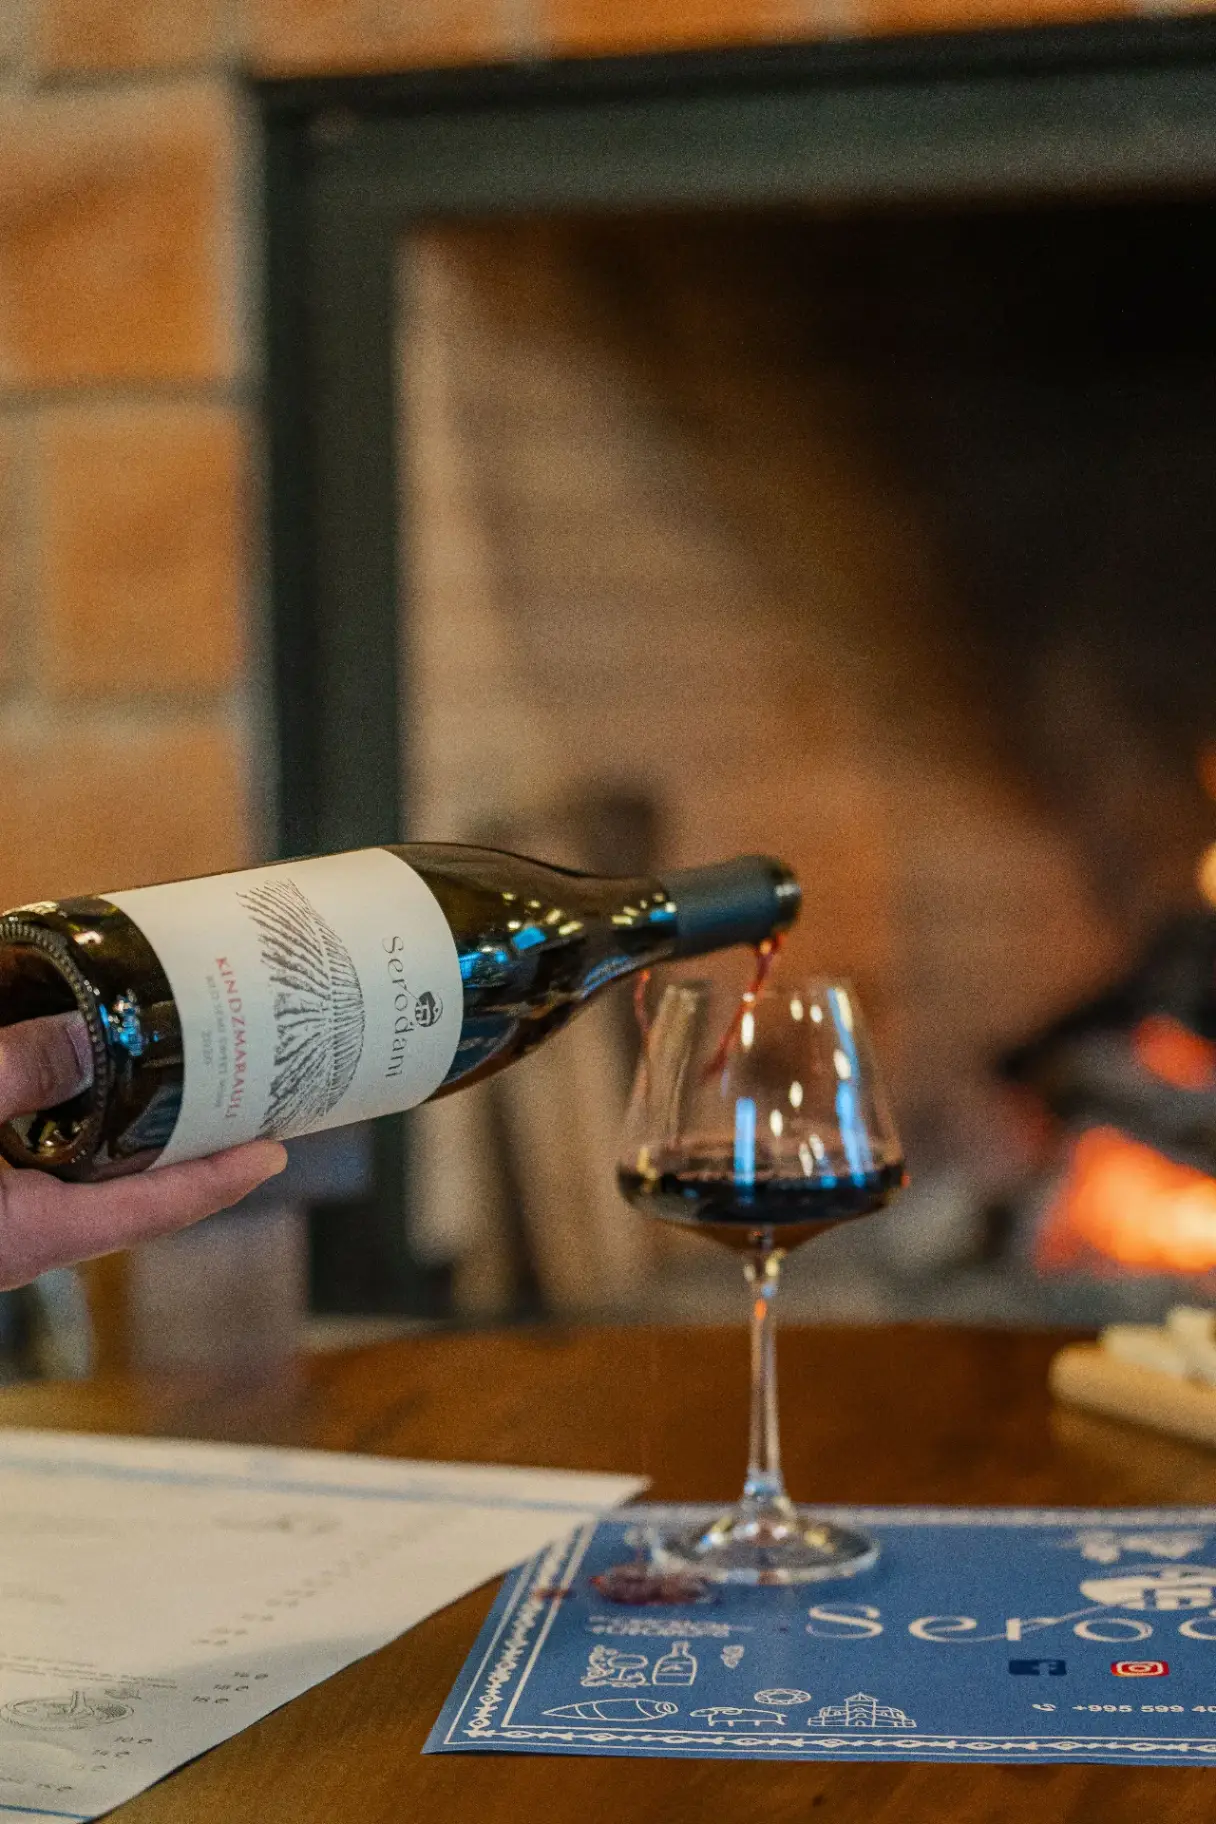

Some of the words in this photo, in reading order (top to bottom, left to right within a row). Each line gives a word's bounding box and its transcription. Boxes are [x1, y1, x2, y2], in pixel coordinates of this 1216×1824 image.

[215, 956, 248, 1120] KINDZMARAULI
[1071, 1704, 1134, 1713] +995
[1140, 1704, 1185, 1713] 599
